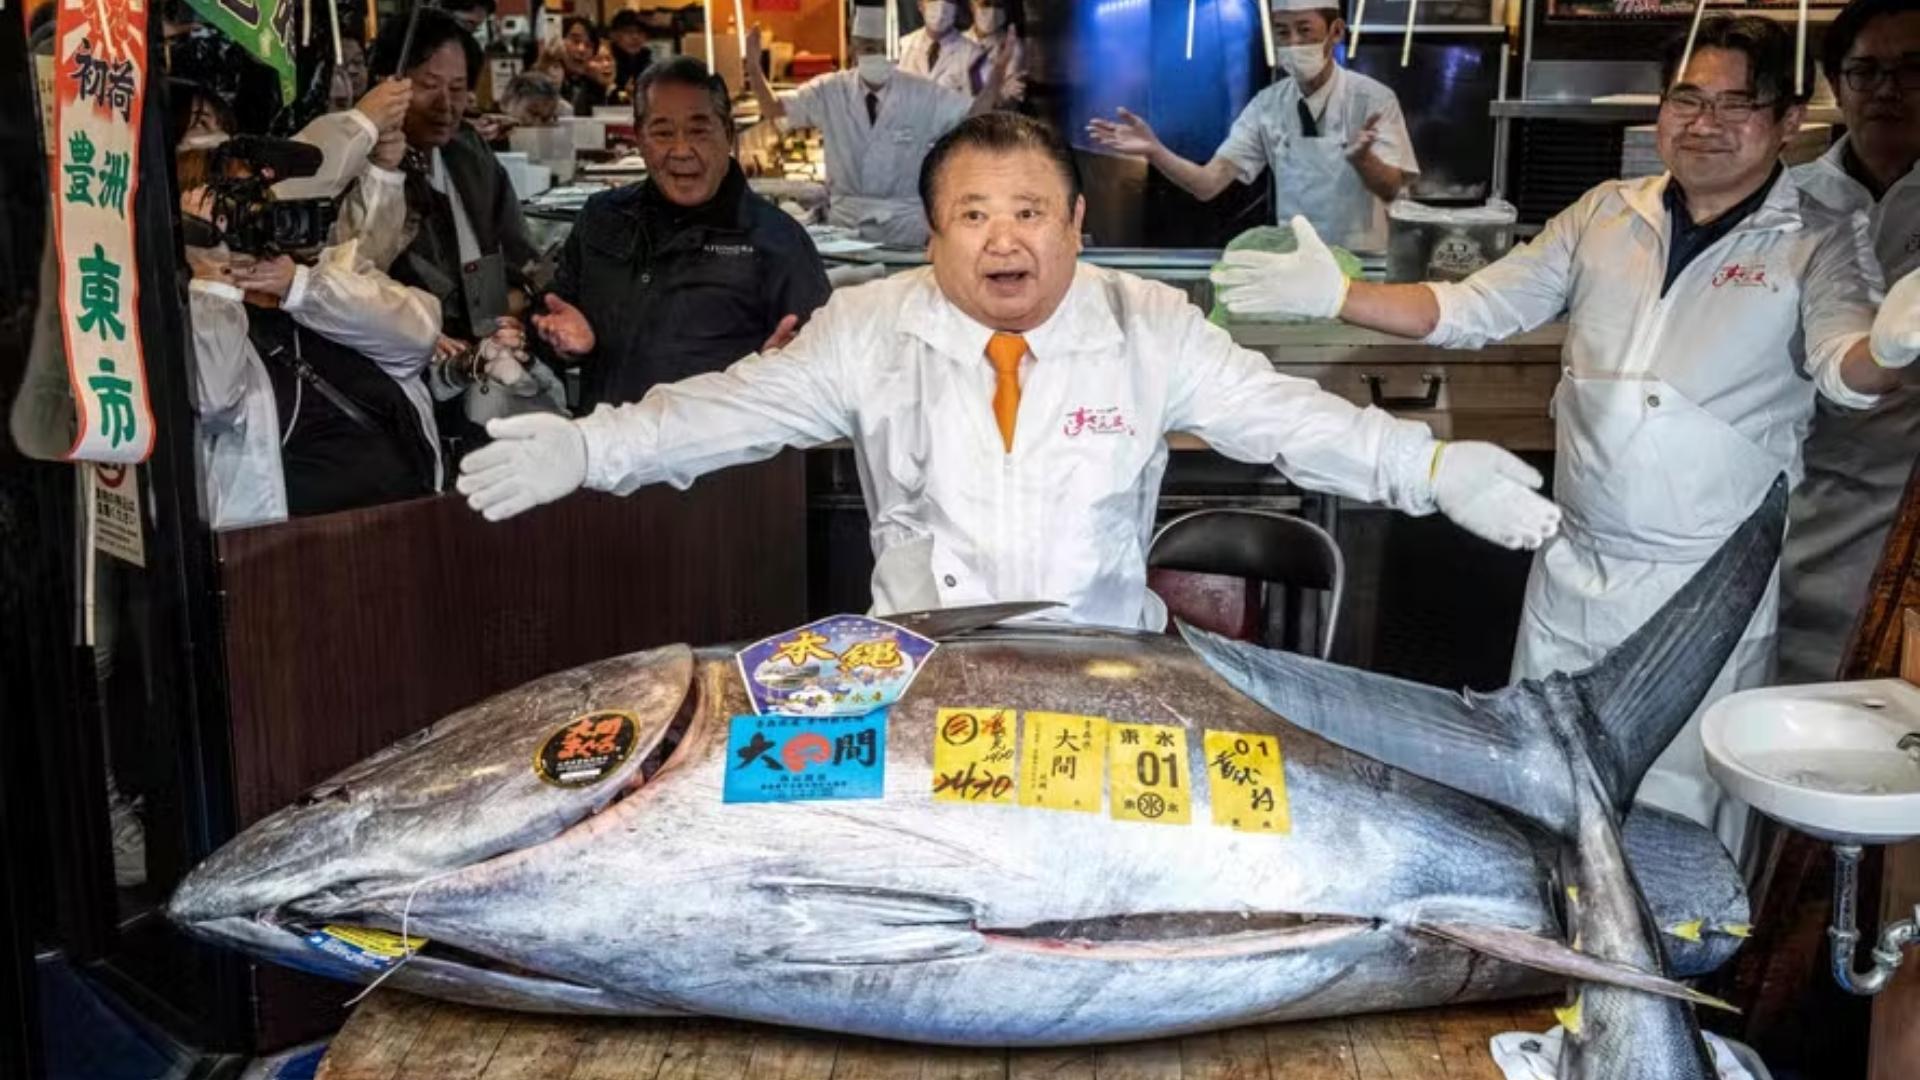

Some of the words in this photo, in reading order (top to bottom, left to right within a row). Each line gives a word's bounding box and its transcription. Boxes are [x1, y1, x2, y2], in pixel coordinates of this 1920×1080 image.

[70, 37, 135, 124] 初荷
[63, 130, 130, 220] 豊洲
[1050, 728, 1080, 780] 大間
[1137, 750, 1178, 789] 01
[1234, 738, 1268, 758] 01
